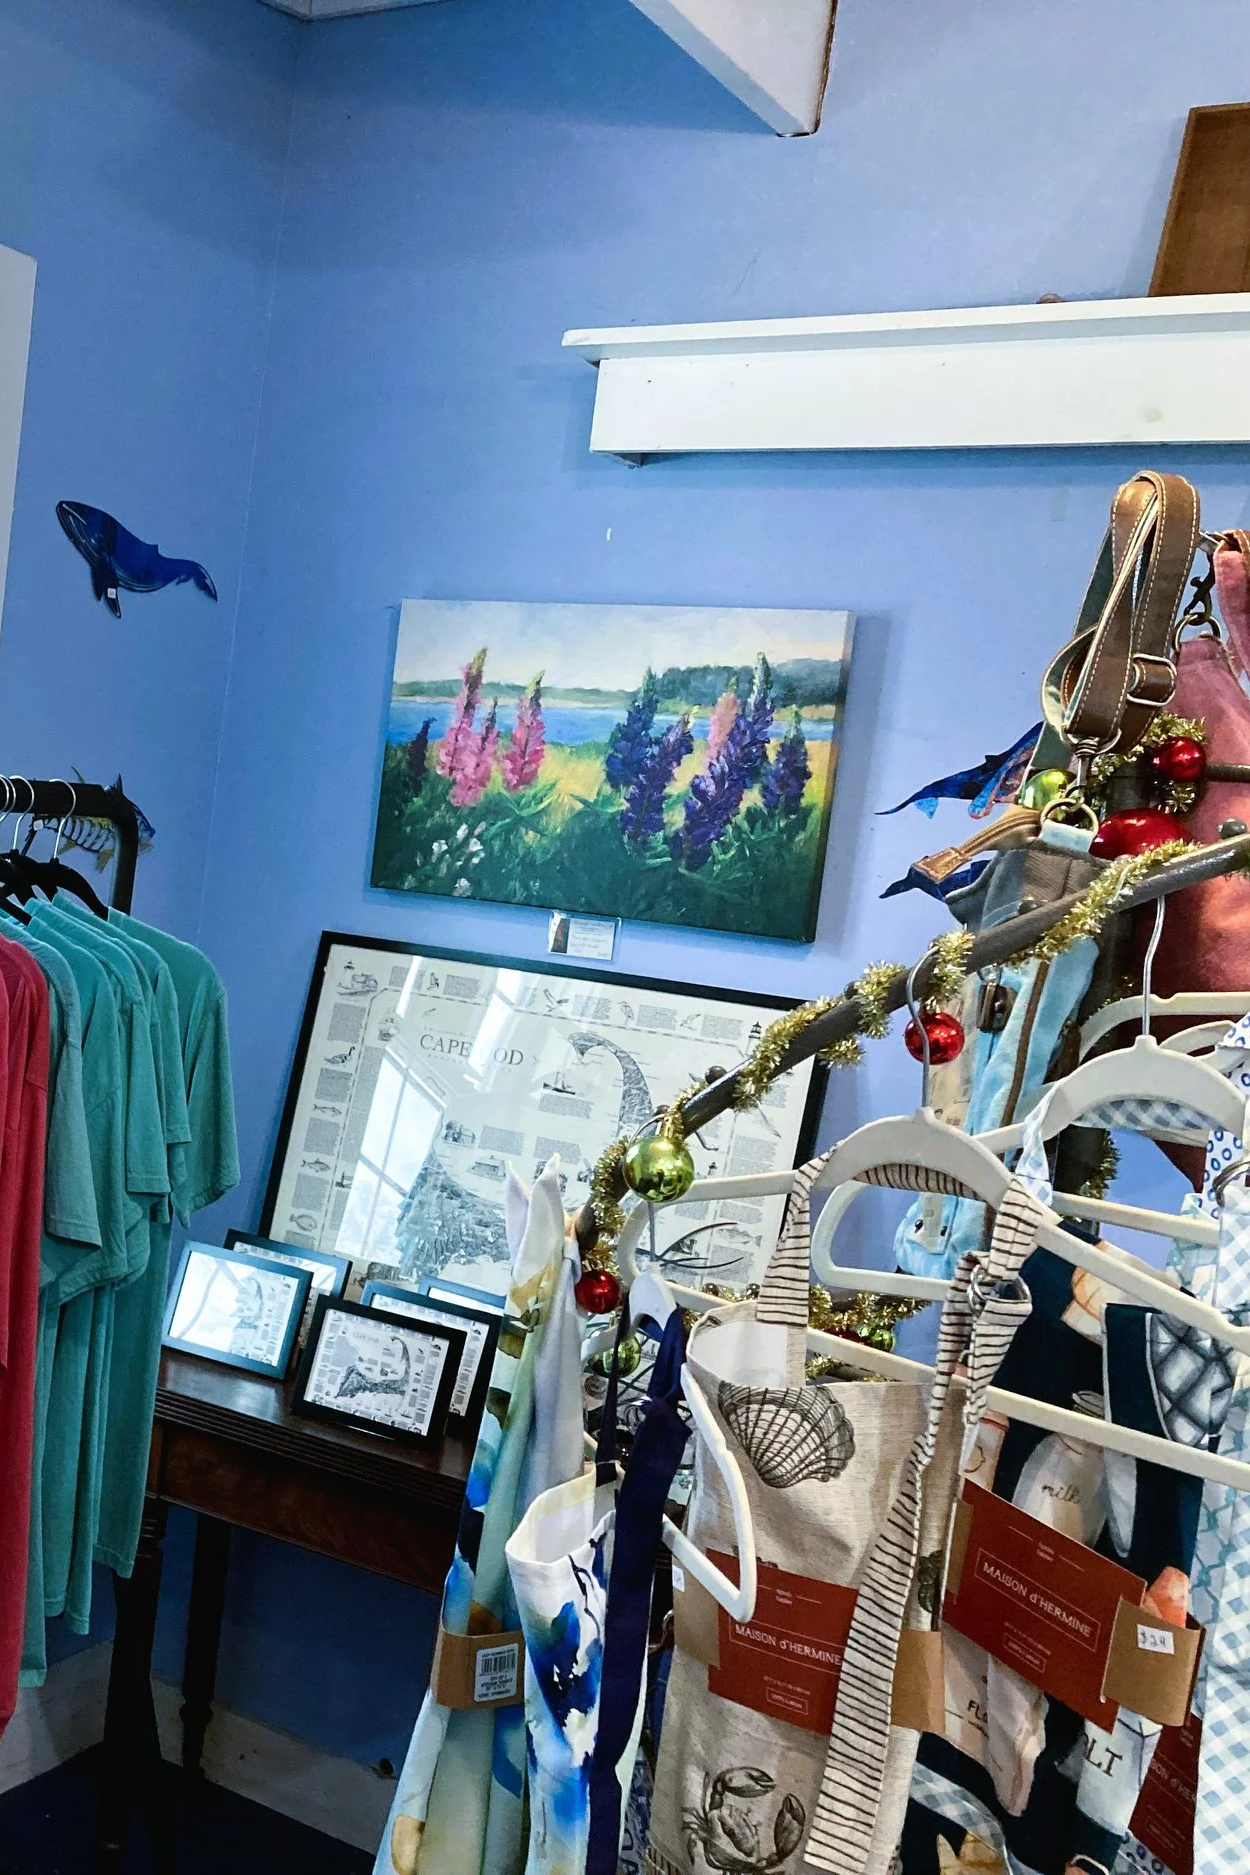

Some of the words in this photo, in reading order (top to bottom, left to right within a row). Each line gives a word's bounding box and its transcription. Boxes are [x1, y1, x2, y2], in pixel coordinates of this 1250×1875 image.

[420, 1033, 473, 1057] CAPE
[1041, 1483, 1082, 1504] milk
[983, 1562, 1028, 1597] MAISON
[1030, 1591, 1092, 1638] d'HERMINE
[735, 1624, 777, 1646] MAISON
[779, 1639, 842, 1666] d'HERMINE
